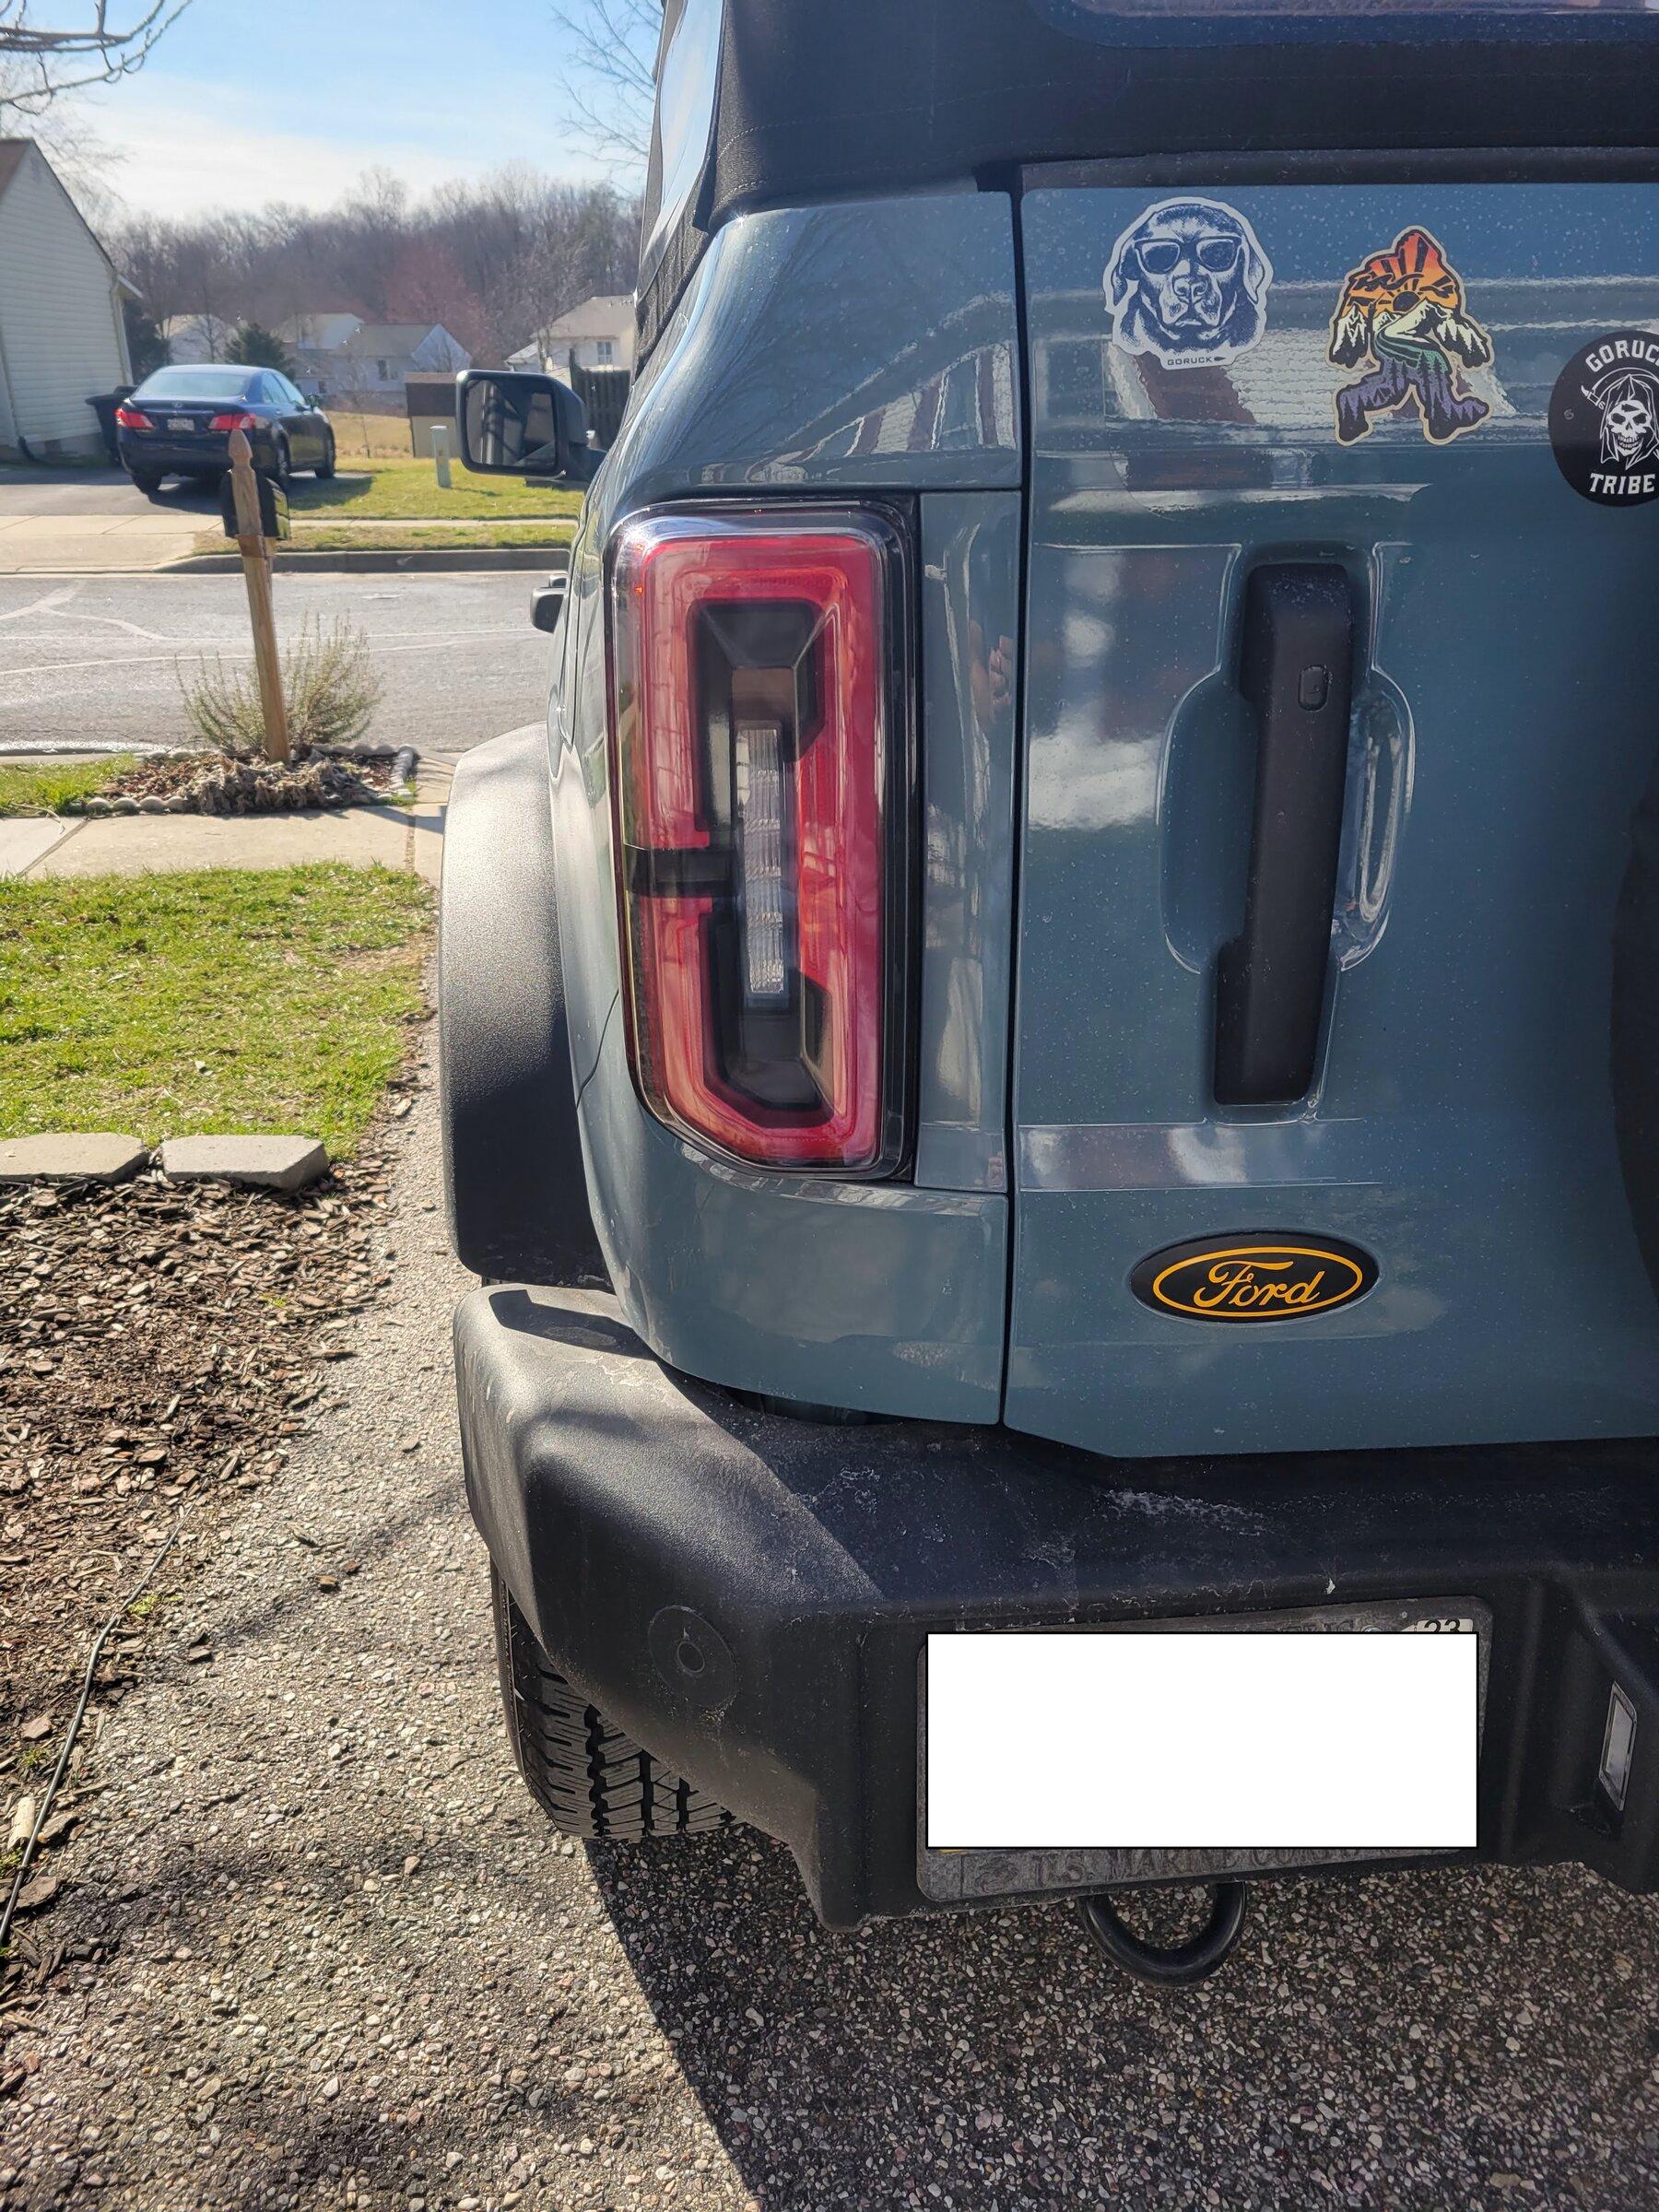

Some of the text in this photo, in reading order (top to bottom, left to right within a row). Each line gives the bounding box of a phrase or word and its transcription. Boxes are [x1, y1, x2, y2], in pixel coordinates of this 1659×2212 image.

[1167, 356, 1213, 366] GORUCK
[1585, 339, 1659, 372] GORUC
[1590, 473, 1655, 495] TRIBE
[1193, 1260, 1325, 1308] Ford
